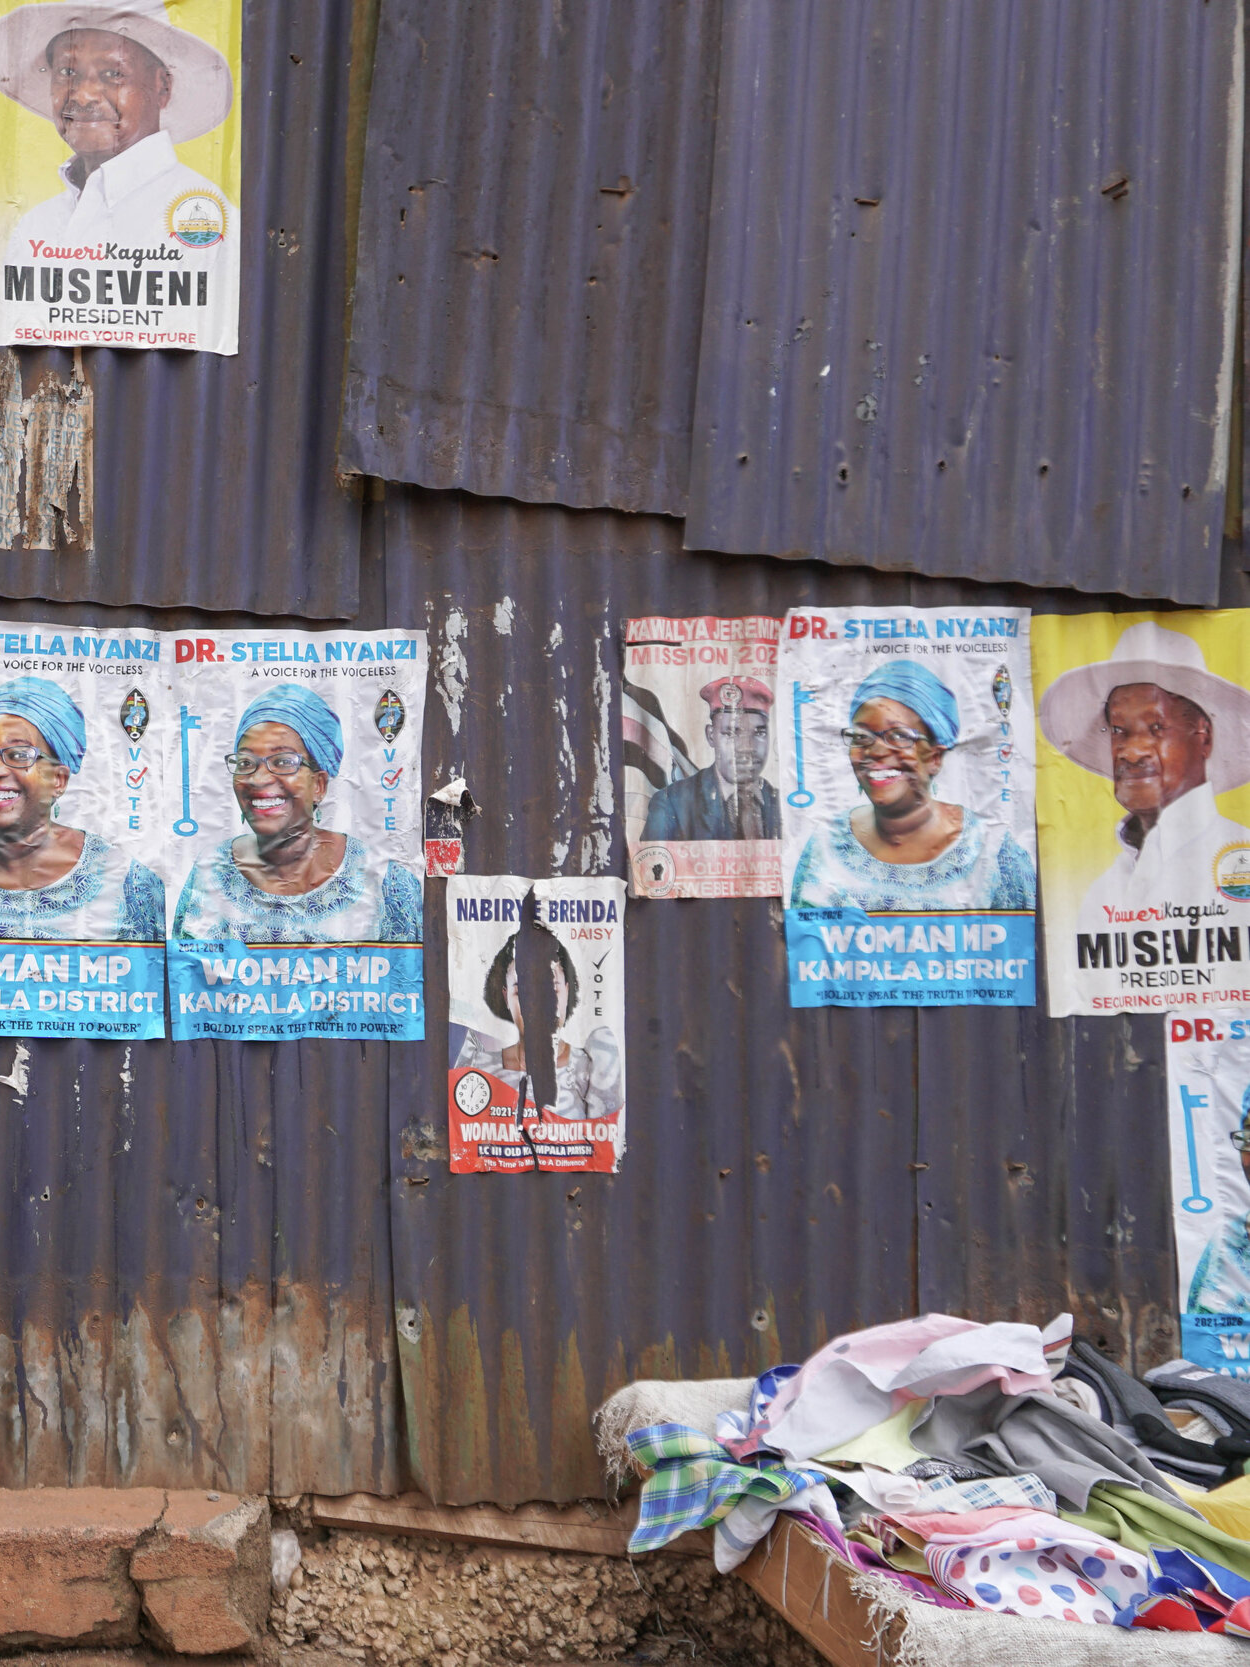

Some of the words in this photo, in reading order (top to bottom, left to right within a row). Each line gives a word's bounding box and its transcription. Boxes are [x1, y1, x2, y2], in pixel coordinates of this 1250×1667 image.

[3, 264, 208, 307] MUSEVENI
[49, 307, 163, 326] PRESIDENT
[14, 327, 90, 342] SECURING
[92, 330, 135, 343] YOUR
[138, 332, 197, 344] FUTURE
[628, 619, 709, 641] KAWALYA
[789, 615, 838, 640] DR.
[844, 618, 930, 639] STELLA
[936, 618, 1020, 638] NYANZI
[72, 636, 161, 662] NYANZI
[174, 638, 225, 664] DR.
[231, 641, 320, 663] STELLA
[325, 639, 417, 663] NYANZI
[631, 646, 729, 666] MISSION
[738, 645, 779, 665] 202
[3, 660, 39, 671] VOICE
[41, 660, 63, 672] FOR
[66, 662, 85, 673] THE
[88, 663, 143, 675] VOICELESS
[251, 667, 259, 678] A
[263, 667, 298, 677] VOICE
[300, 668, 317, 679] FOR
[320, 667, 338, 678] THE
[342, 666, 397, 678] VOICELESS
[725, 861, 782, 875] KAMPA
[549, 899, 618, 923] BRENDA
[570, 928, 614, 940] DAISY
[819, 924, 956, 953] WOMAN
[963, 924, 1007, 952] MP
[1076, 926, 1250, 969] MUSEVEN
[79, 955, 132, 984] MP
[200, 957, 338, 986] WOMAN
[346, 956, 391, 984] MP
[798, 959, 923, 982] KAMPALA
[928, 958, 1029, 980] DISTRICT
[1121, 968, 1216, 988] PRESIDENT
[38, 990, 158, 1013] DISTRICT
[178, 991, 306, 1014] KAMPALA
[310, 990, 419, 1014] DISTRICT
[1092, 993, 1163, 1009] SECURING
[9, 1020, 33, 1031] THE
[36, 1020, 76, 1032] TRUTH
[78, 1022, 95, 1032] TO
[204, 1023, 244, 1034] BOLDLY
[247, 1024, 285, 1035] SPEAK
[287, 1023, 307, 1033] THE
[308, 1021, 345, 1032] TRUTH
[1171, 1018, 1224, 1043] DR.
[490, 1106, 538, 1118] 2021-026
[460, 1122, 522, 1142] WOMAN
[529, 1122, 619, 1142] COUNCILLOR
[504, 1147, 521, 1156] OLD
